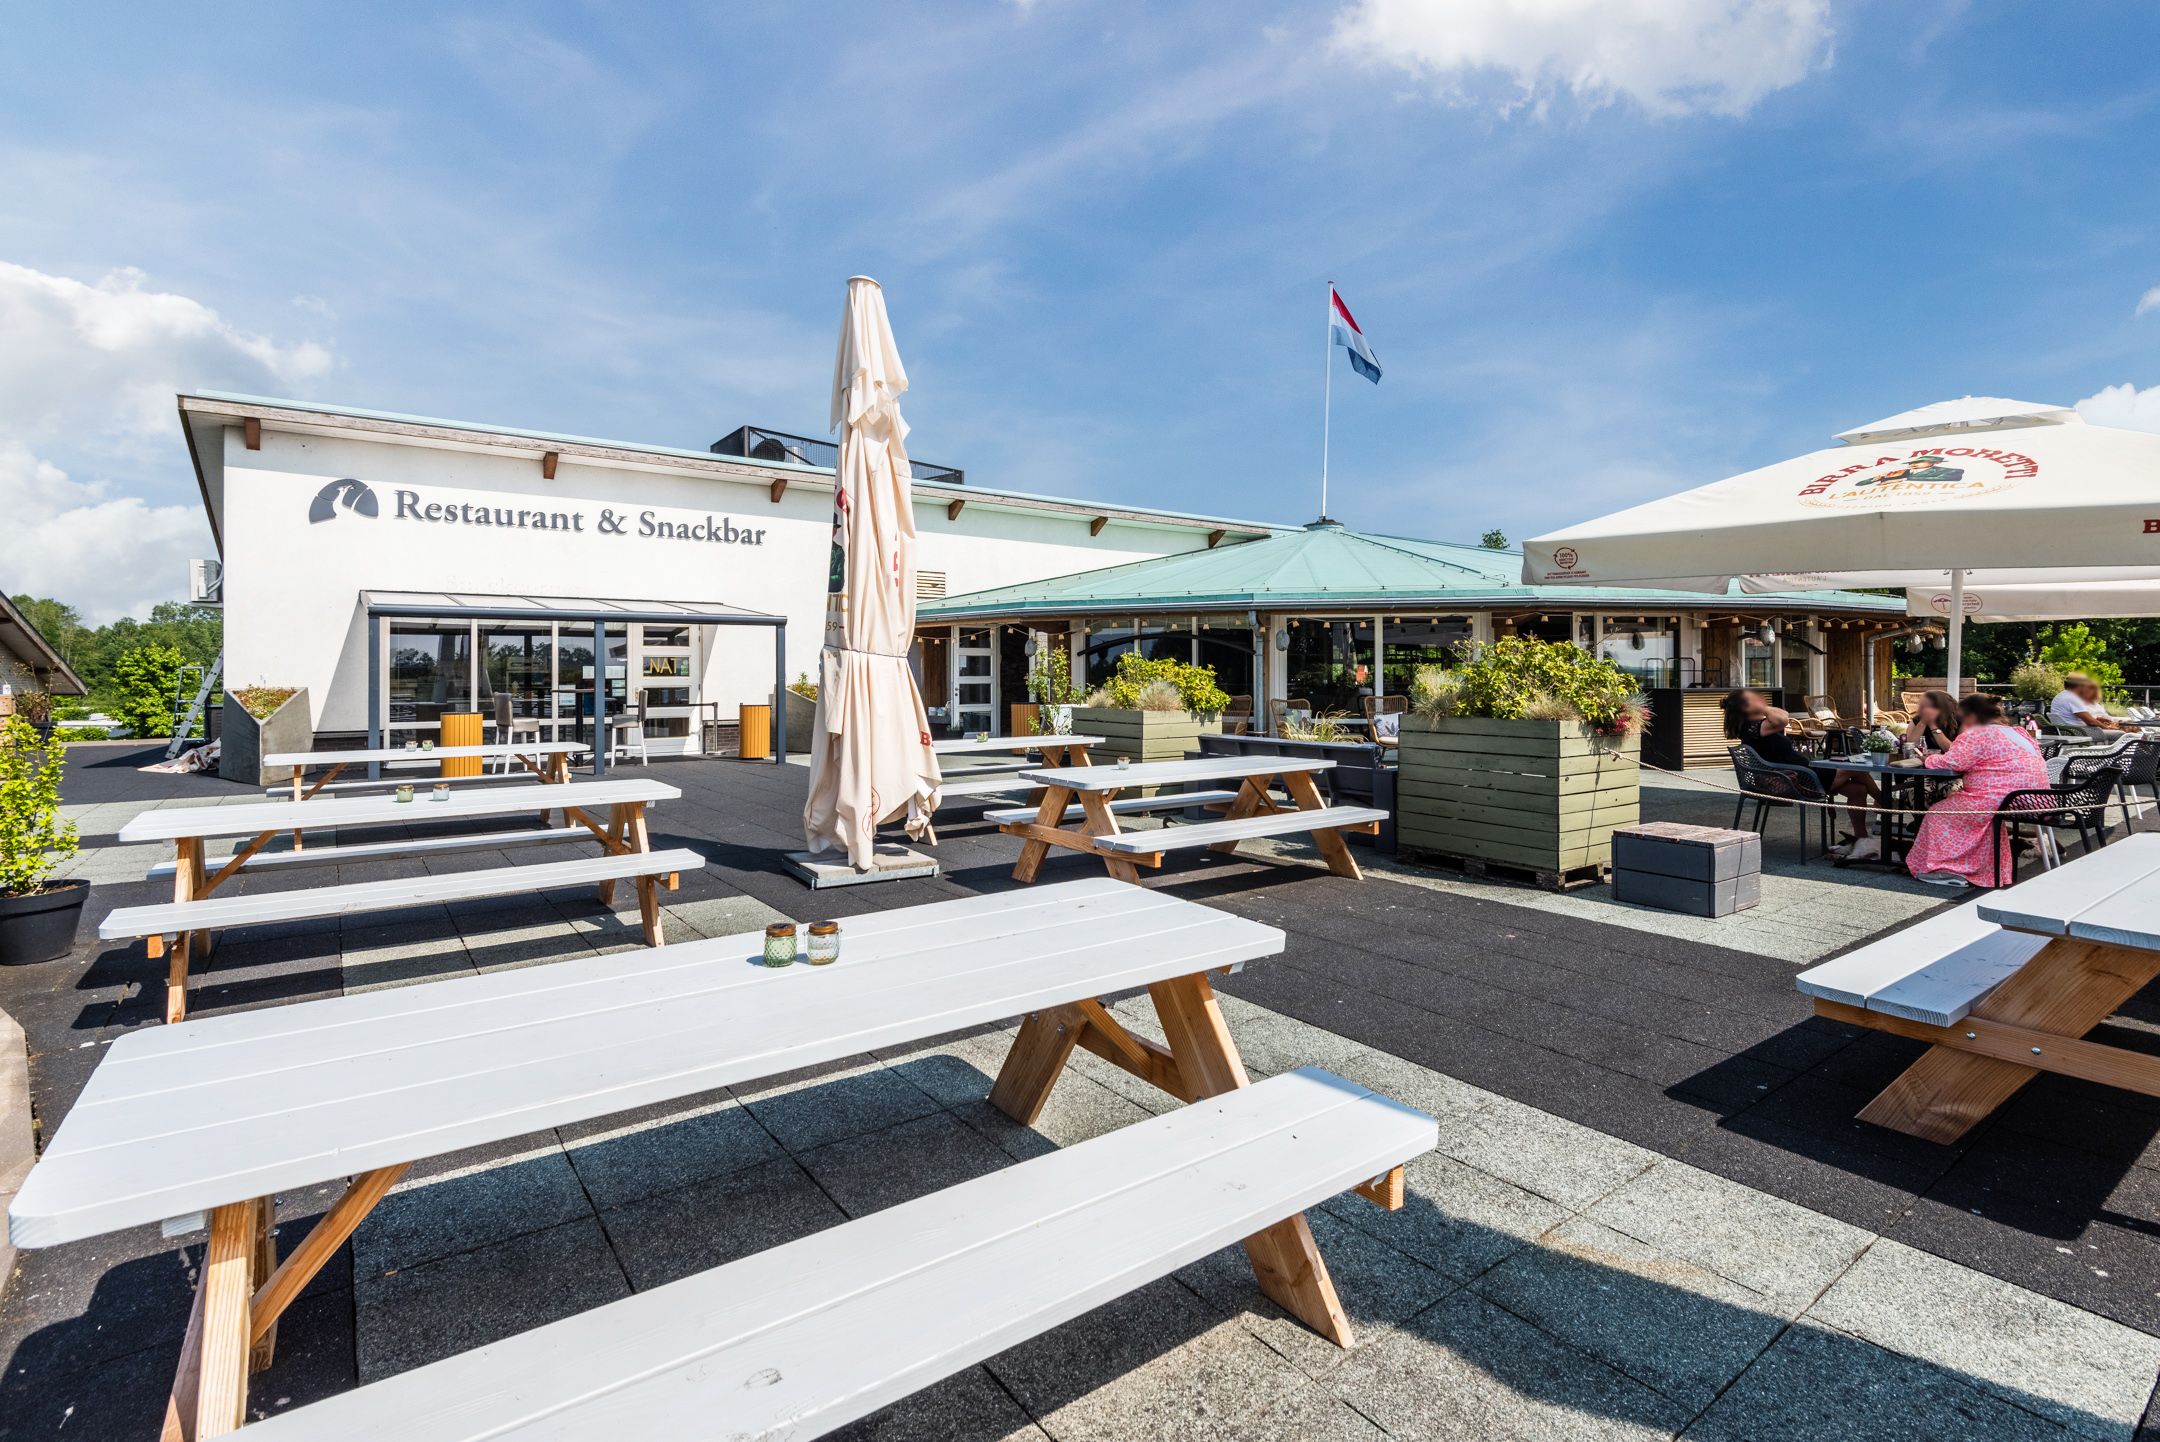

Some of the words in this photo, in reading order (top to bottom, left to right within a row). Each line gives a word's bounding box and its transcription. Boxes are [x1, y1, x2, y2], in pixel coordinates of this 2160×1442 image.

[1798, 456, 1901, 496] BIRRA
[1909, 448, 2040, 480] MORETTI
[394, 489, 585, 532] Restaurant
[597, 508, 628, 535] &
[638, 511, 767, 546] Snackbar
